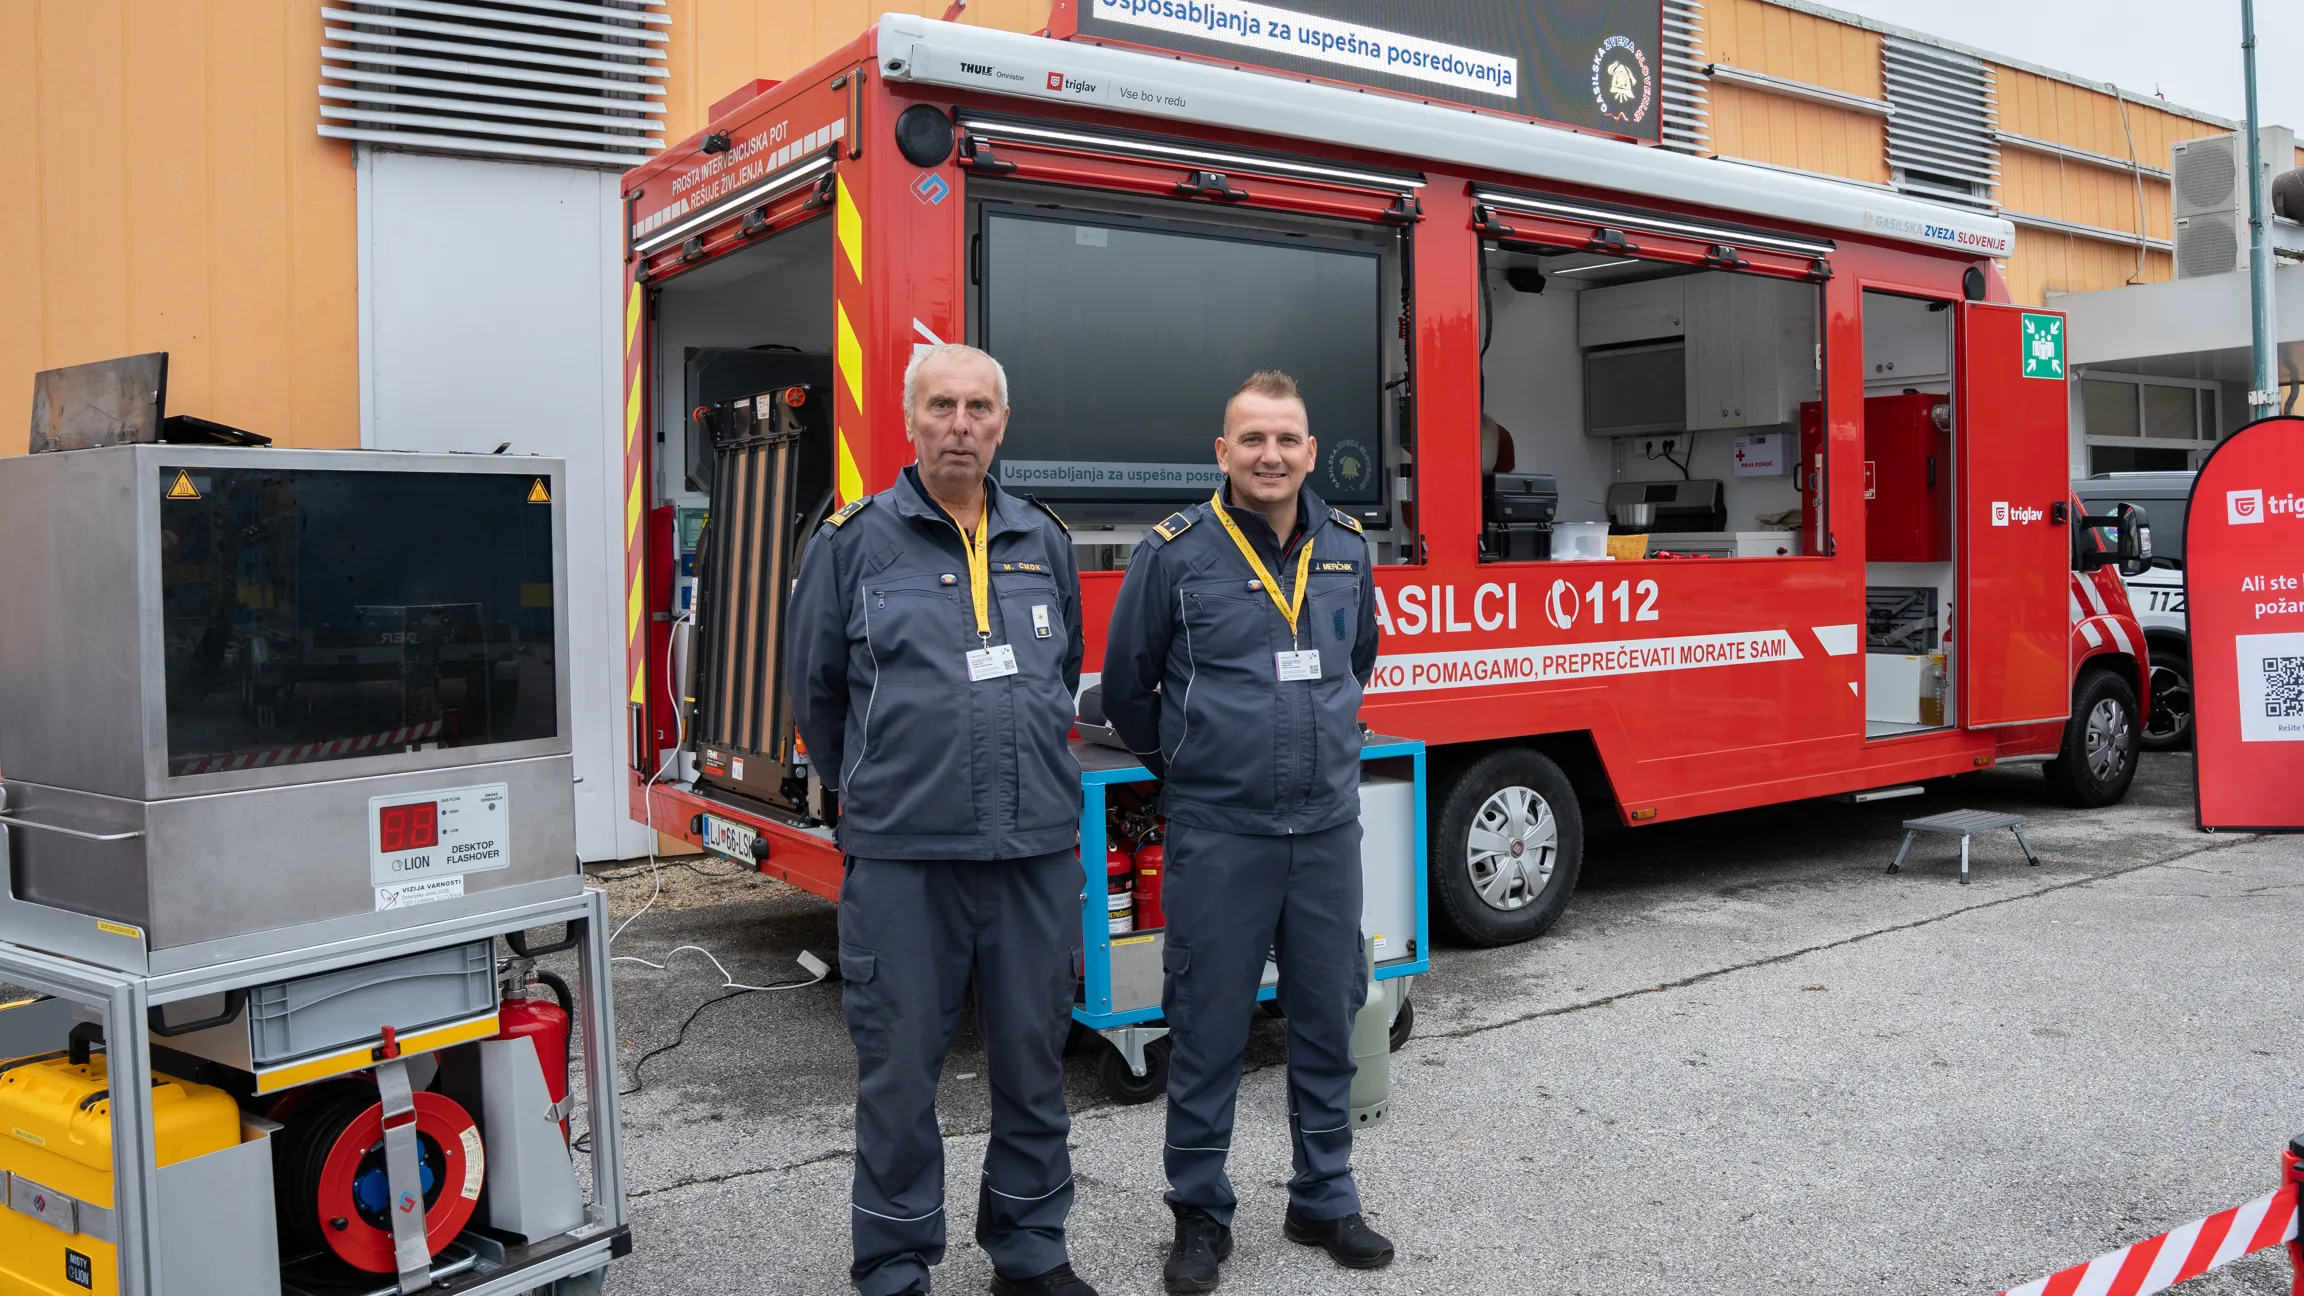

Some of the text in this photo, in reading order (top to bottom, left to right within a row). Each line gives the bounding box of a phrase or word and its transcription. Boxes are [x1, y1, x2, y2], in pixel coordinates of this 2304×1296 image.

[1103, 0, 1512, 87] sposabljanja za uspešna posredovanja
[960, 62, 1025, 81] THULE Omnistor
[1592, 47, 1607, 113] GASILSKA
[1604, 35, 1635, 54] ZVEZA
[1065, 78, 1096, 94] triglav
[1120, 87, 1187, 108] Vse bo v redu
[672, 120, 789, 196] PROSTA INTERVENCIJSKA POT
[690, 159, 764, 210] REŠUJE ŽIVLJENJA
[1875, 215, 2006, 250] GASILSKA ZVEZA SLOVENIJE
[1004, 466, 1104, 482] Usposabljanja
[1108, 470, 1123, 480] za
[1127, 468, 1182, 484] uspešna
[2010, 506, 2043, 525] triglav
[2241, 575, 2298, 592] Ali ste
[1585, 579, 1659, 624] 112
[2149, 590, 2186, 613] 112
[1412, 657, 1539, 685] POMAGAMO,
[1543, 646, 1675, 676] PREPREČEVATI
[1680, 641, 1746, 664] MORATE
[1750, 638, 1787, 659] SAMI
[2278, 724, 2301, 732] Rešite
[710, 821, 720, 846] LJ
[452, 840, 494, 854] DESKTOP
[404, 855, 430, 871] LION
[446, 849, 500, 865] FLASHOVER
[402, 879, 461, 893] VIZIJA VARNOSTI
[69, 1253, 88, 1269] MISTY
[75, 1267, 89, 1285] LION
